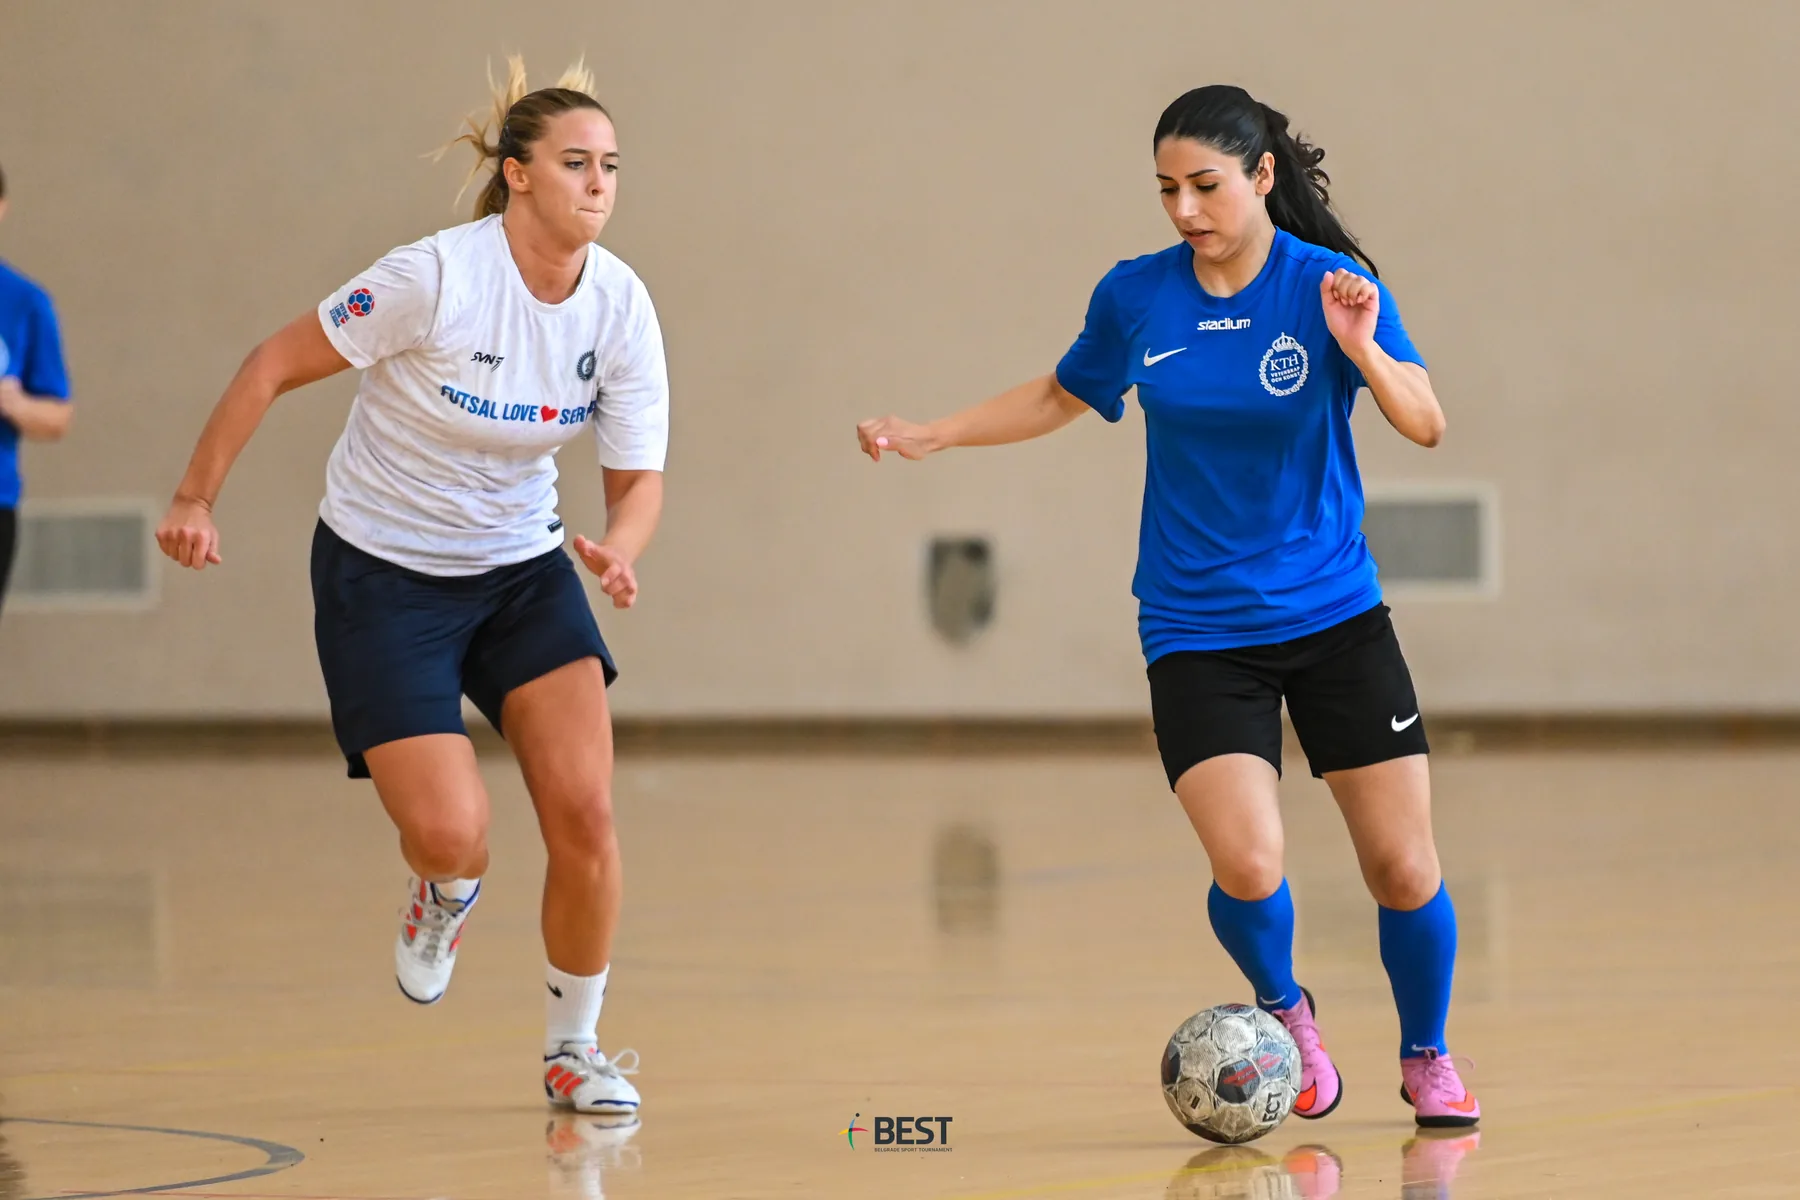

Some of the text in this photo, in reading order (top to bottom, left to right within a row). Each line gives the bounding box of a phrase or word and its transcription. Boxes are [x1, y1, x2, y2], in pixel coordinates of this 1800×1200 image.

[1196, 317, 1251, 331] stadium
[1269, 353, 1299, 371] KTH
[440, 384, 498, 420] FUTSAL
[502, 403, 539, 422] LOVE
